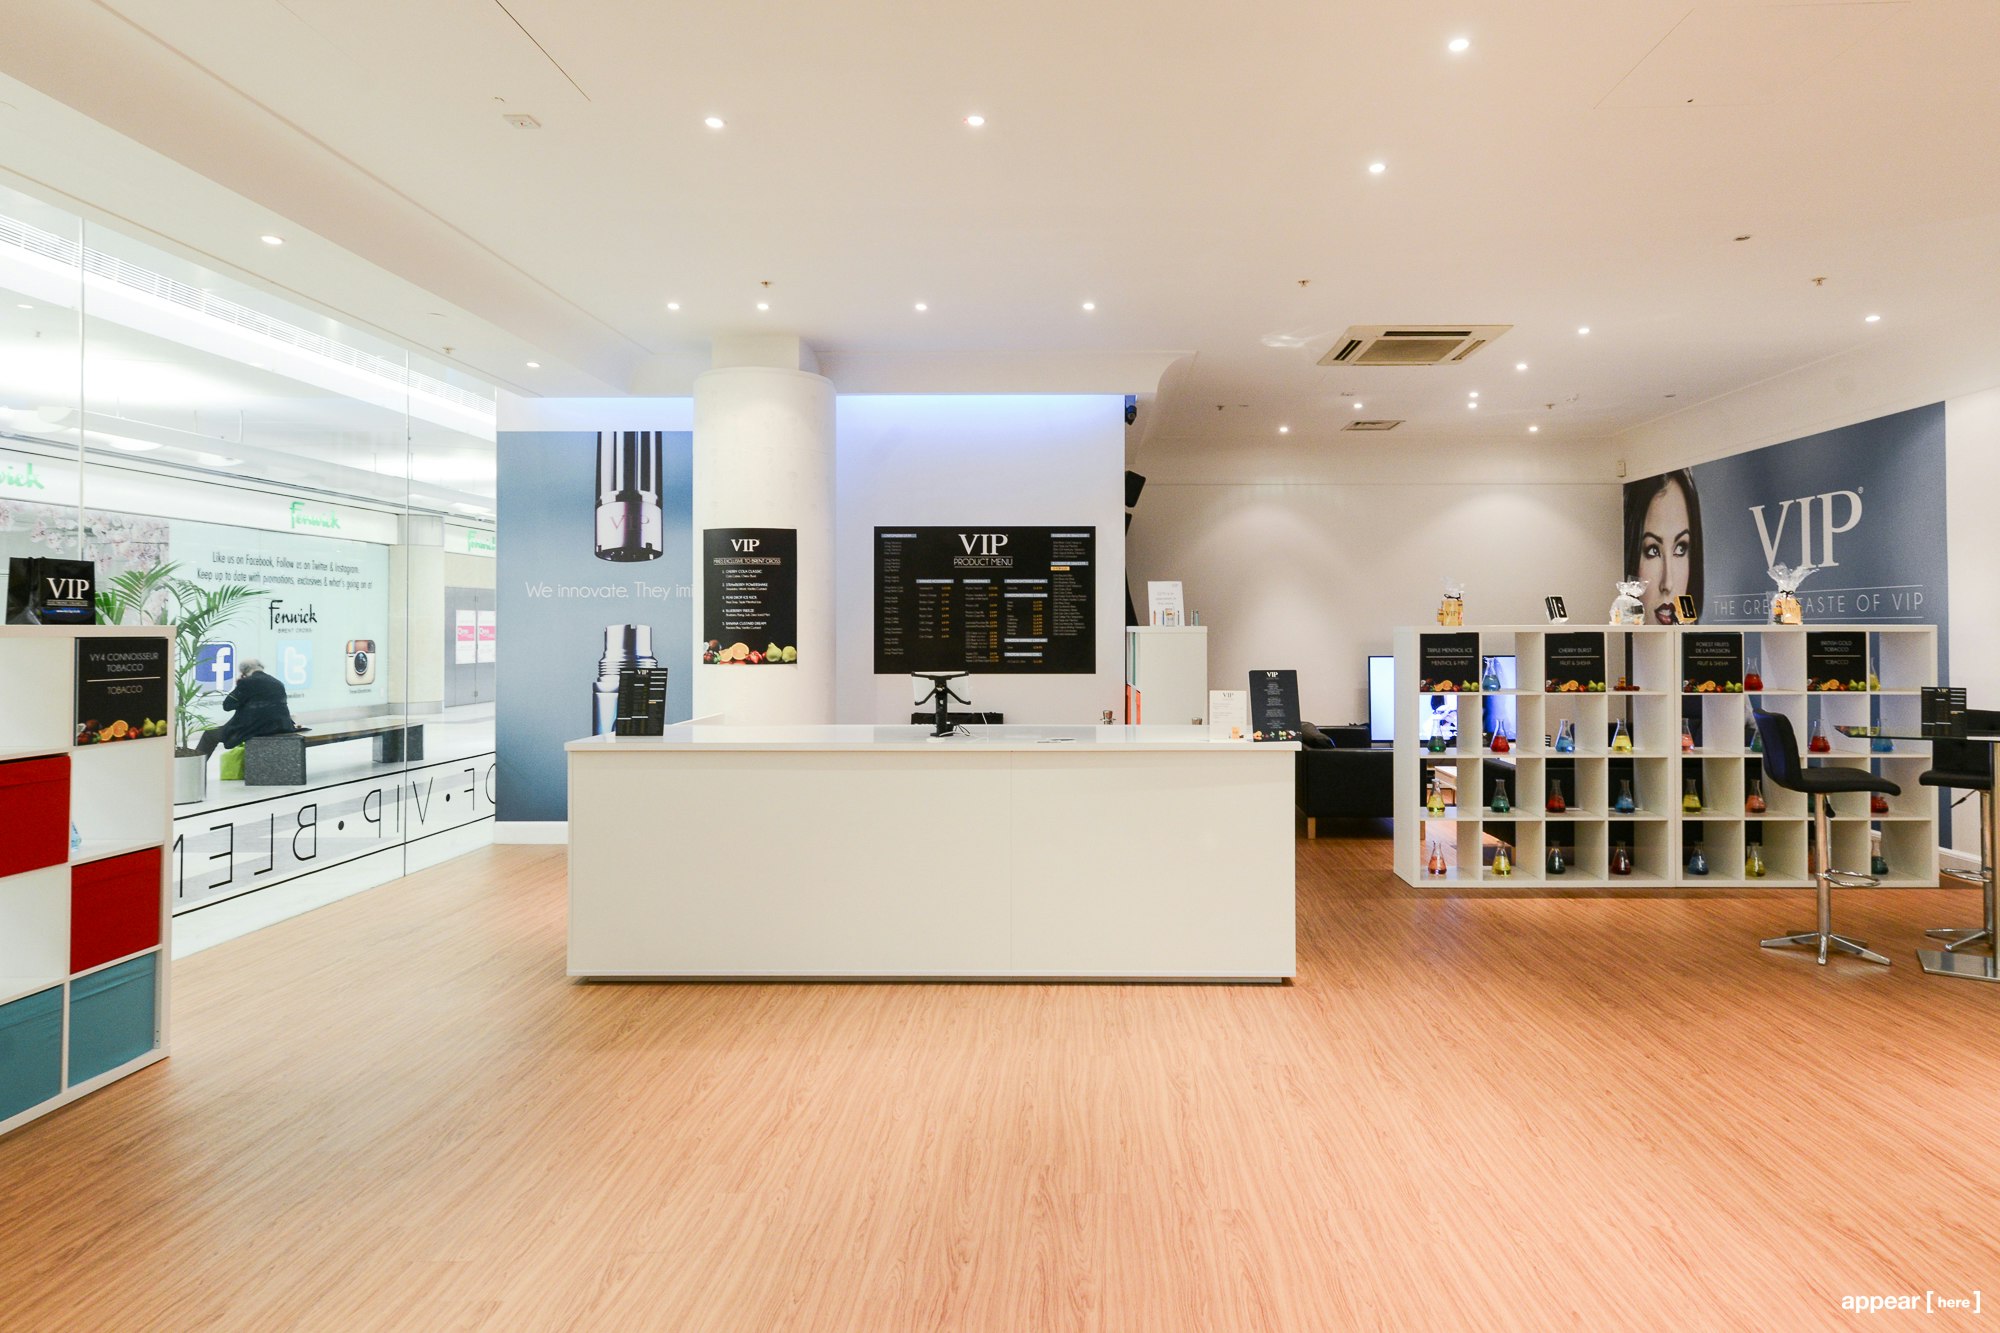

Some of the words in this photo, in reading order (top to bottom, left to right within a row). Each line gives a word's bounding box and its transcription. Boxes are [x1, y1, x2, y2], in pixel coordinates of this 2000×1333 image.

[289, 501, 341, 529] Fenwick
[1749, 490, 1863, 570] VIP
[731, 538, 761, 552] VIP
[958, 533, 1008, 556] VIP
[212, 552, 225, 563] Like
[227, 556, 235, 564] us
[236, 557, 244, 565] on
[276, 557, 294, 568] Follow
[304, 562, 311, 570] on
[312, 560, 328, 571] Twitter
[953, 558, 989, 566] PRODUCT
[990, 558, 1013, 566] MENU
[197, 568, 212, 583] Keep
[214, 572, 223, 583] up
[225, 571, 231, 580] to
[233, 570, 247, 581] date
[46, 577, 90, 600] VIP
[525, 581, 553, 598] We
[557, 583, 629, 599] innovate.
[634, 581, 671, 600] They
[1713, 600, 1736, 616] THE
[1856, 594, 1880, 612] OF
[1892, 592, 1924, 611] VIP
[268, 599, 317, 630] Fenwick
[106, 652, 160, 661] CONNOISSEUR
[106, 663, 144, 672] TOBACCO
[107, 685, 144, 694] TOBACCO
